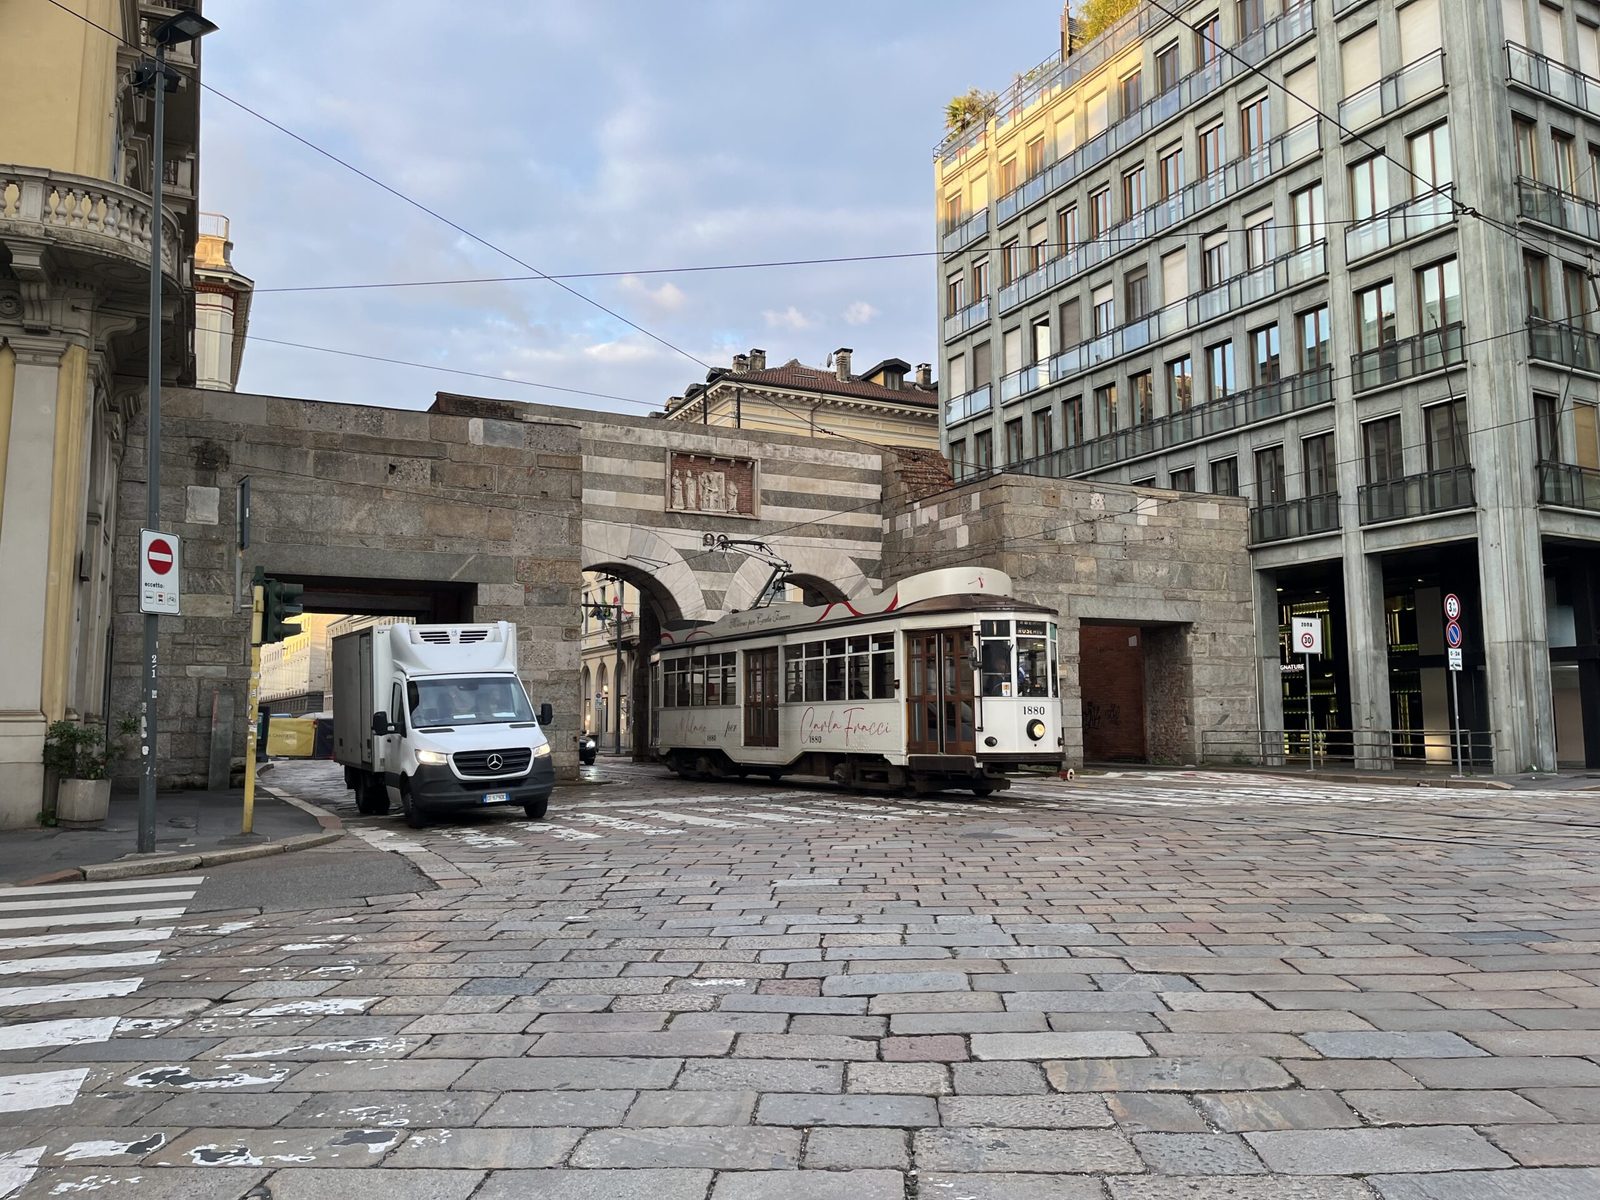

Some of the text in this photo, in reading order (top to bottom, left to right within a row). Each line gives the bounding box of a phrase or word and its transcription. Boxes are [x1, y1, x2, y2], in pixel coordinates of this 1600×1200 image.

[1304, 636, 1312, 644] 30
[1023, 705, 1045, 715] 1880
[724, 721, 738, 737] per
[801, 706, 891, 746] Carla Fracci
[809, 736, 822, 744] 1880
